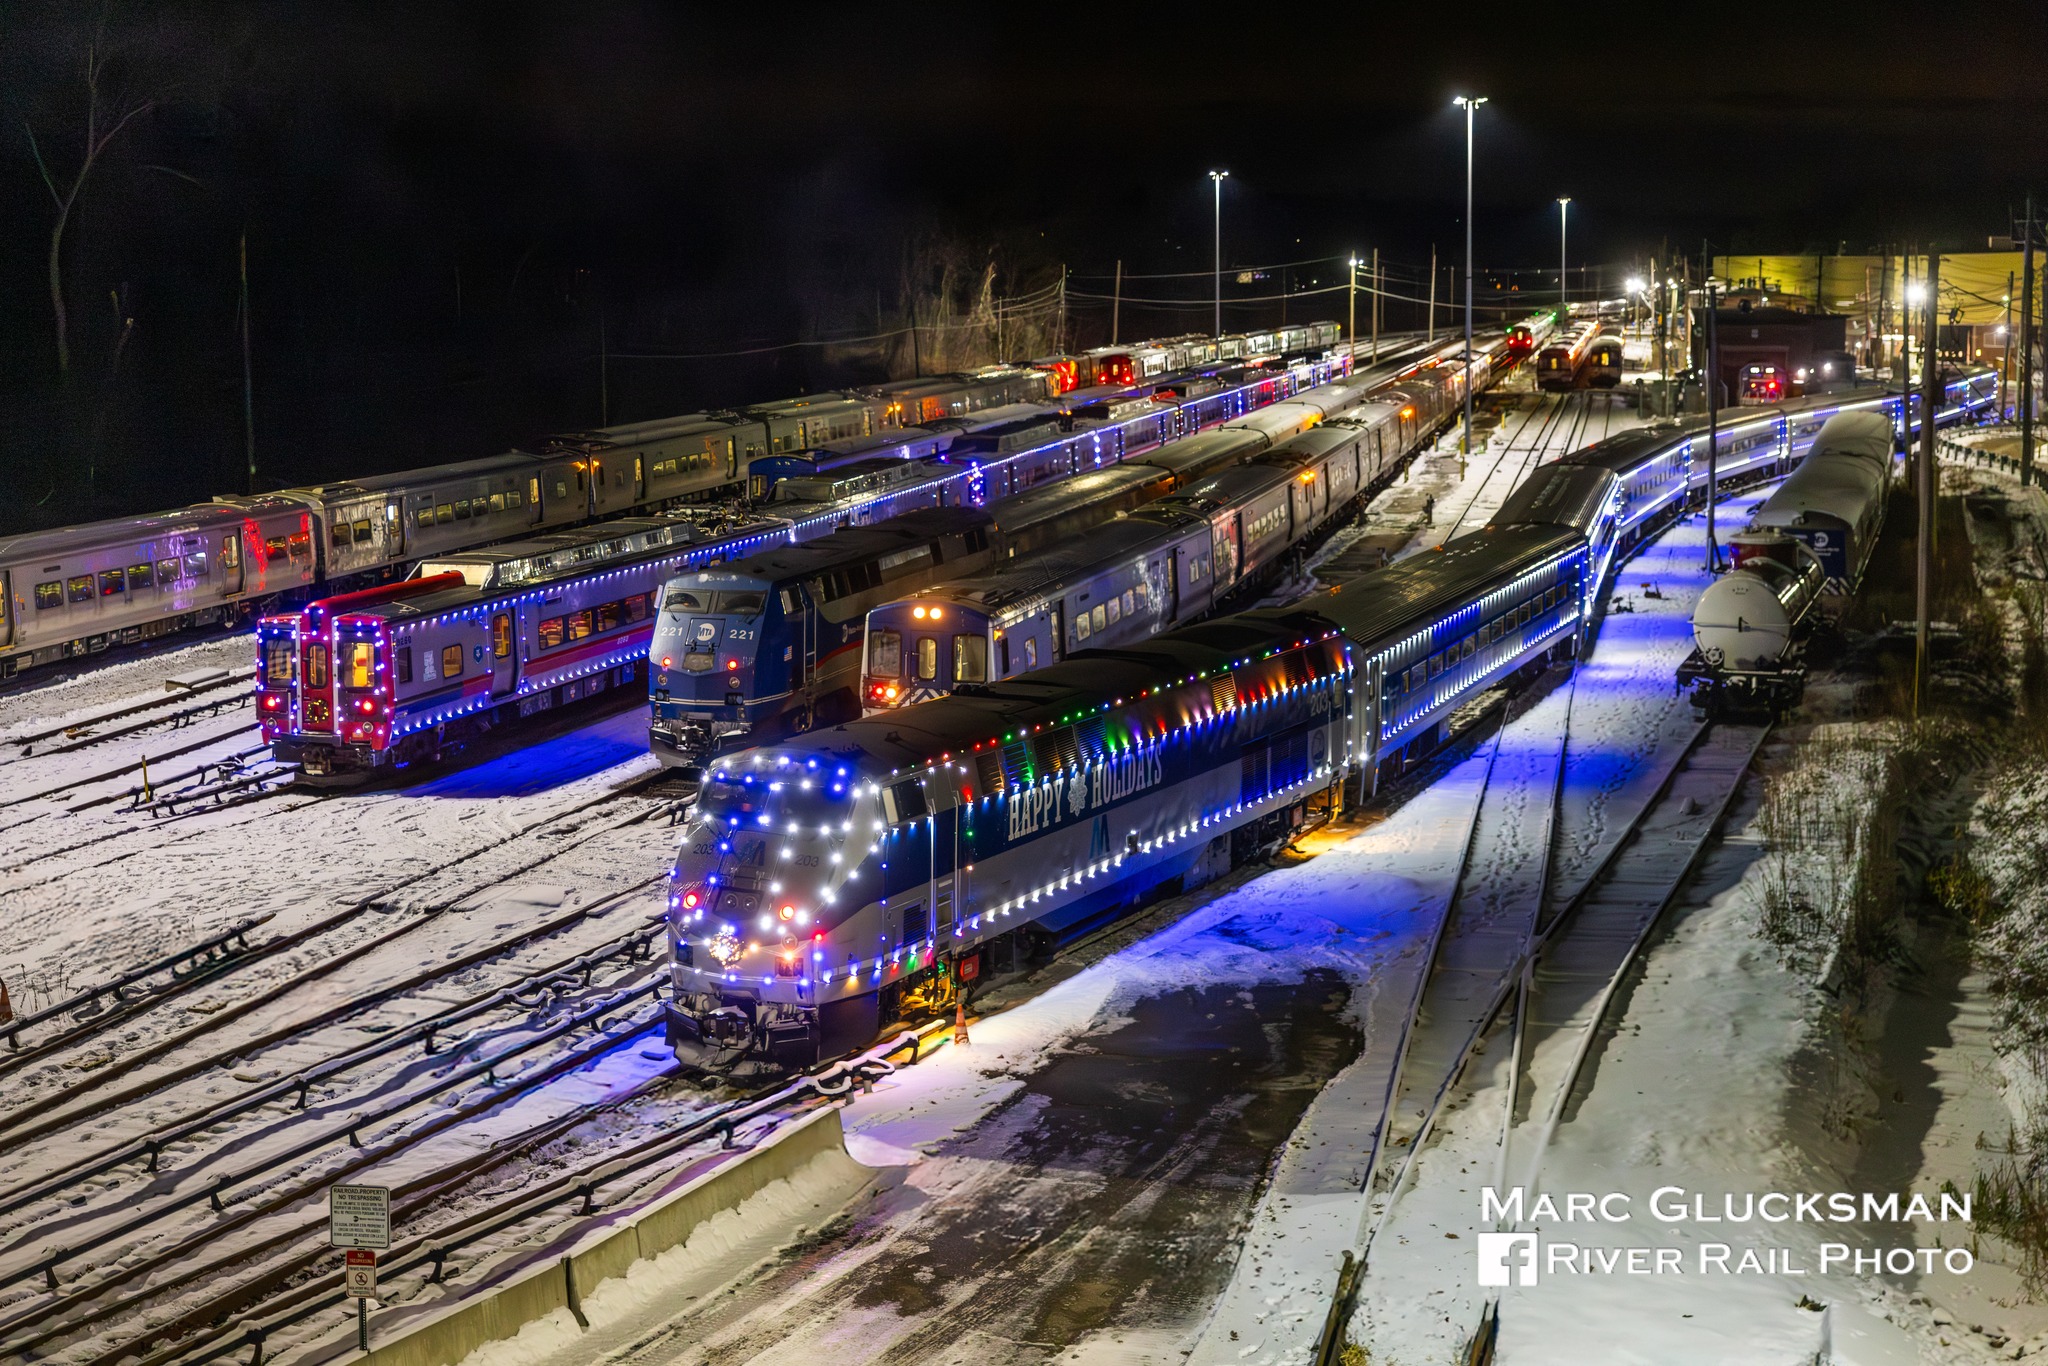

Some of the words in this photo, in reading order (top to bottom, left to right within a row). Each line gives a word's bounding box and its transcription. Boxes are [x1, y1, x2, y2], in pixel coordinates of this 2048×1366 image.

[660, 626, 683, 637] 221
[698, 626, 713, 638] MTA
[729, 629, 754, 640] 221
[1310, 689, 1329, 717] 203
[1008, 777, 1065, 842] HAPPY
[1091, 743, 1162, 809] HOLIDAYS
[693, 843, 715, 855] 203
[794, 854, 819, 868] 203
